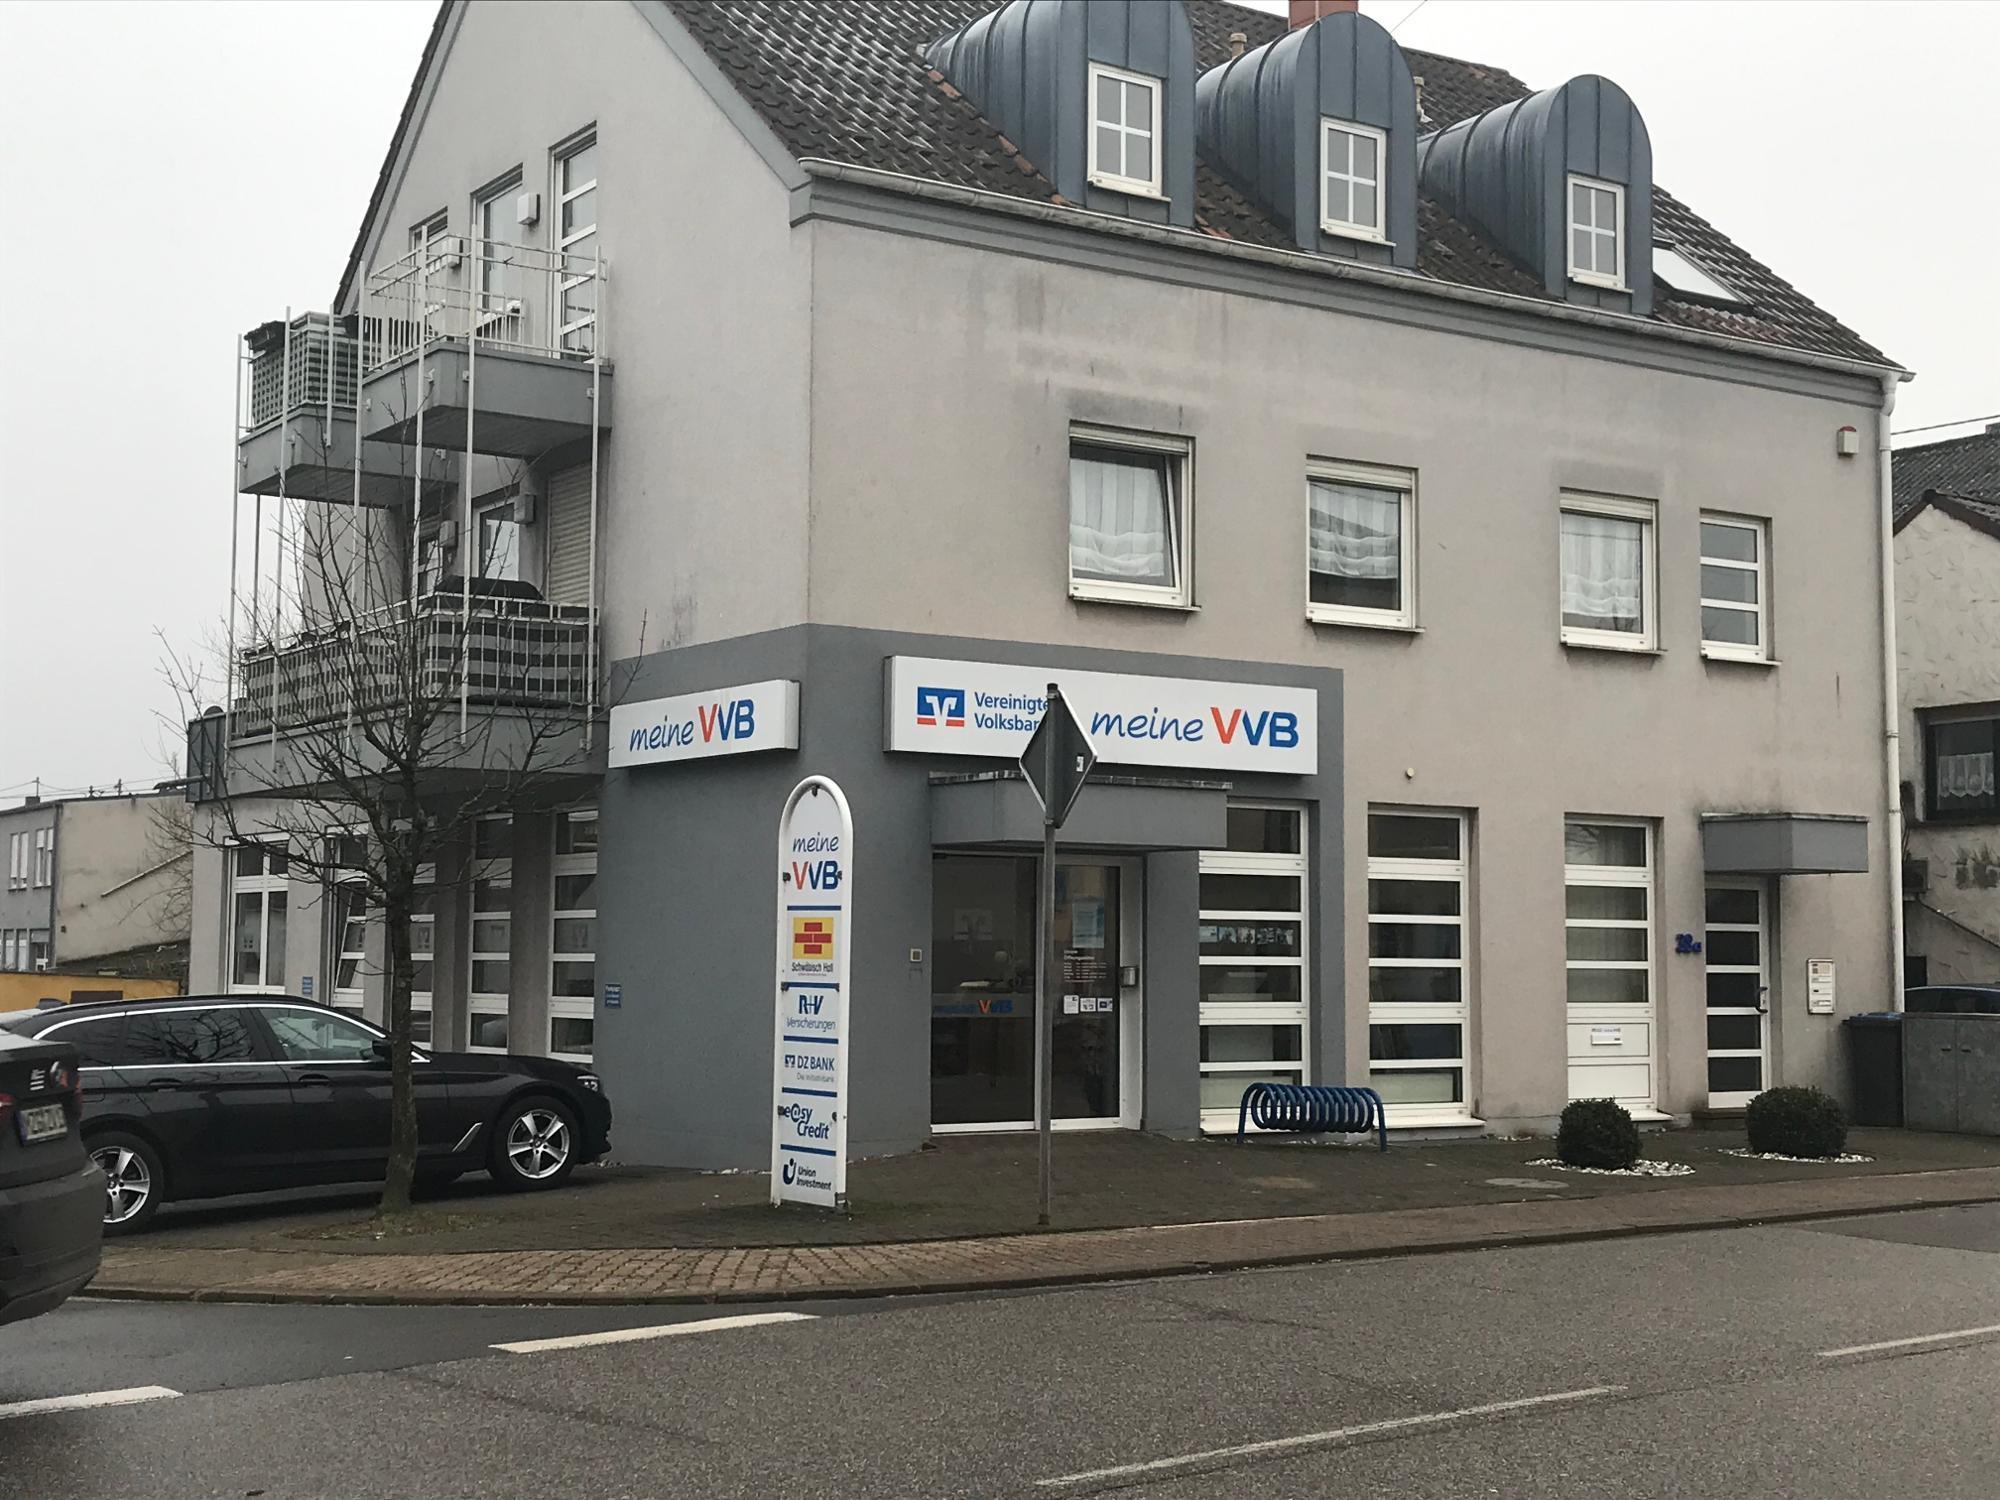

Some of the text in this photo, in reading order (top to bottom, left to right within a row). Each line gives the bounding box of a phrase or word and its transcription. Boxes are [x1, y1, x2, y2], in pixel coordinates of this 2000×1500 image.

[974, 691, 1049, 715] Vereinigte
[629, 699, 755, 752] meine VVB
[974, 712, 1041, 732] Volksba
[1090, 706, 1300, 749] meine VVB
[792, 832, 839, 853] meine
[792, 860, 839, 890] VVB
[786, 1017, 836, 1033] Versicherungen
[797, 1055, 835, 1071] DZ BANK
[784, 1103, 813, 1125] e@sy
[797, 1120, 830, 1139] Credit
[798, 1166, 816, 1177] Union
[796, 1177, 832, 1191] Investment
